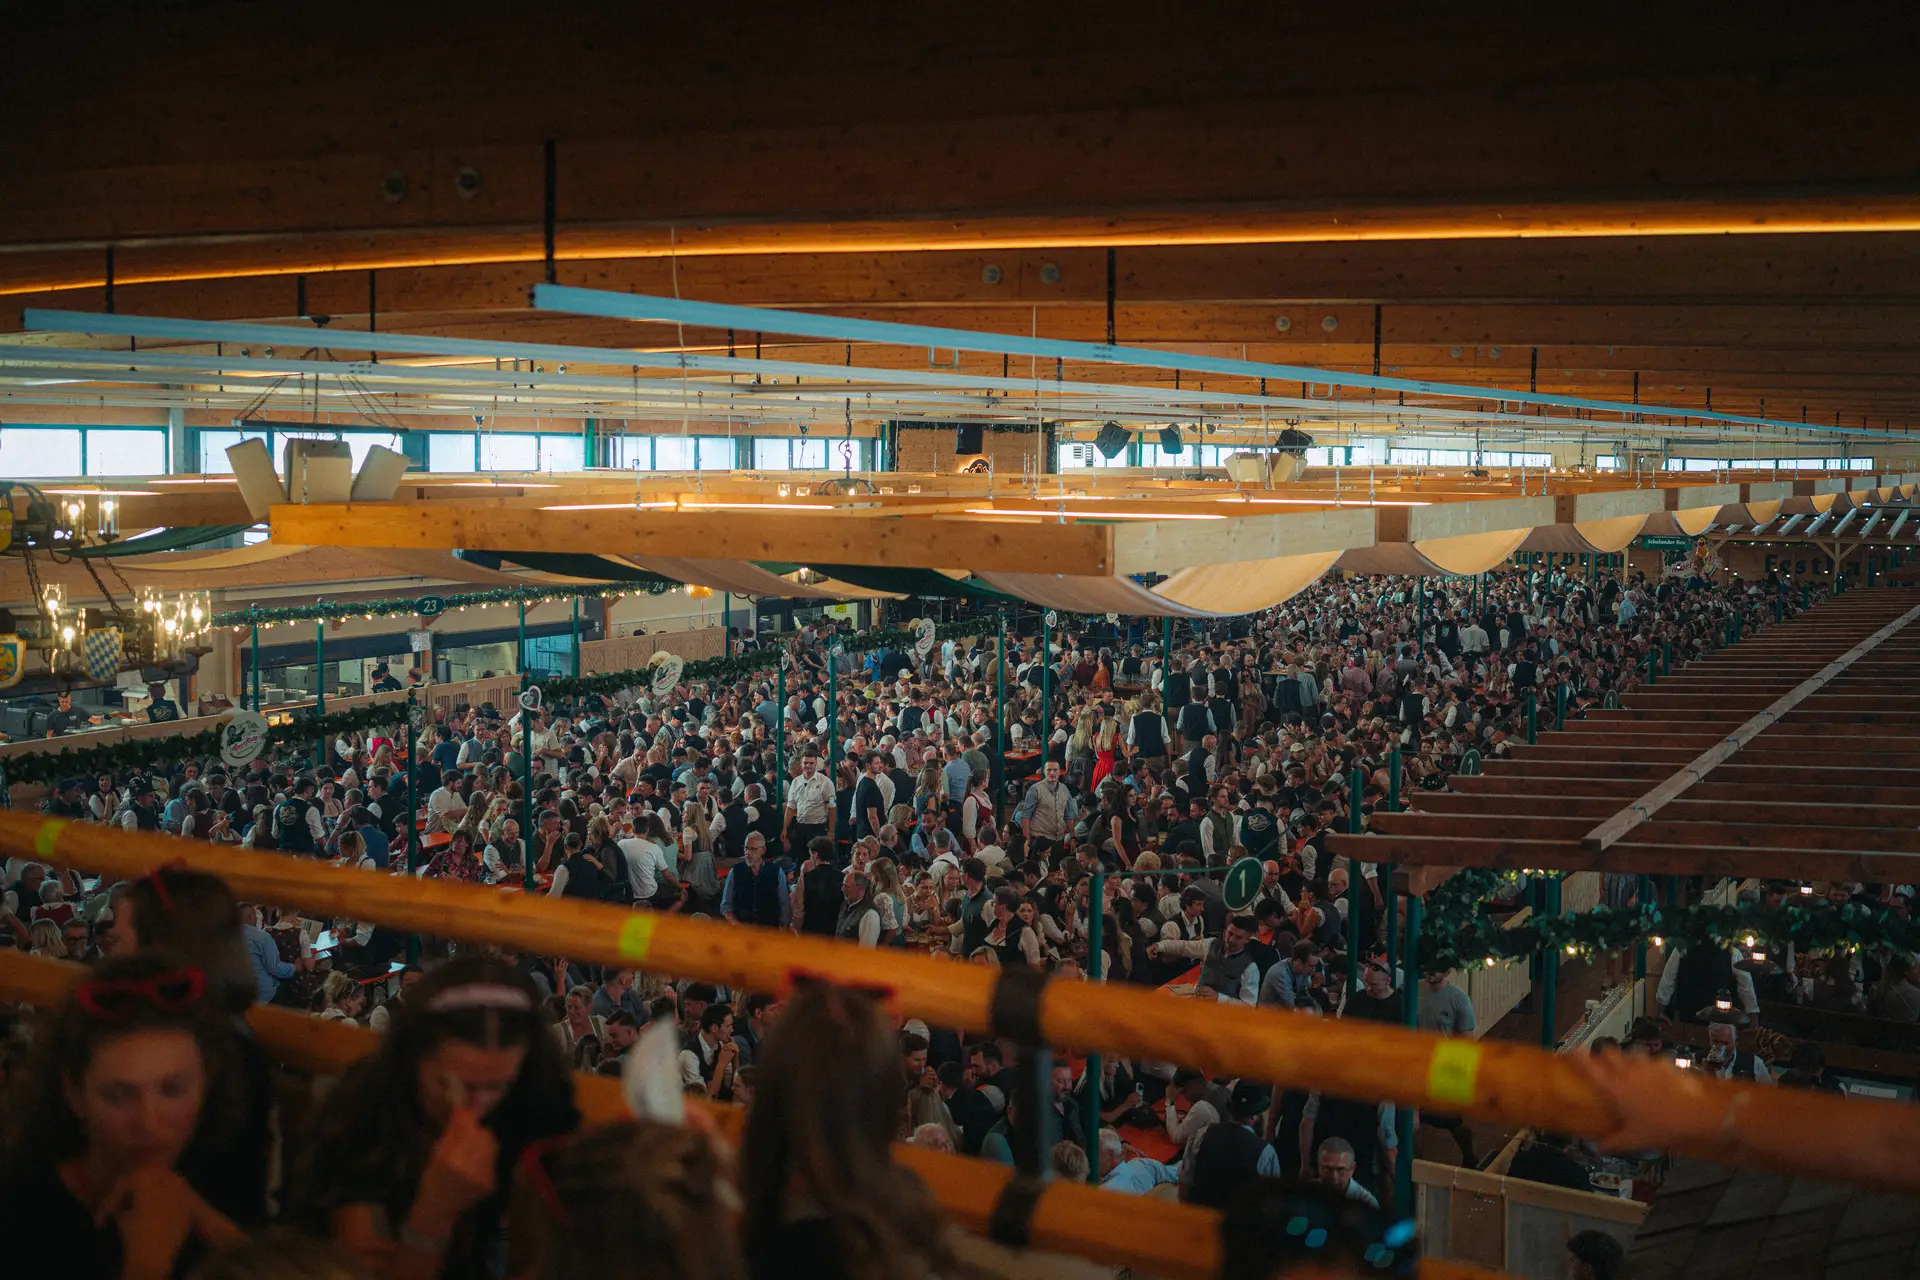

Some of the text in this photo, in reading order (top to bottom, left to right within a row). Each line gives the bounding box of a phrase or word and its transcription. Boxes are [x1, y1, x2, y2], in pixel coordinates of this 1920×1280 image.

[652, 581, 664, 592] 24
[423, 599, 437, 613] 23
[1238, 868, 1246, 898] 1
